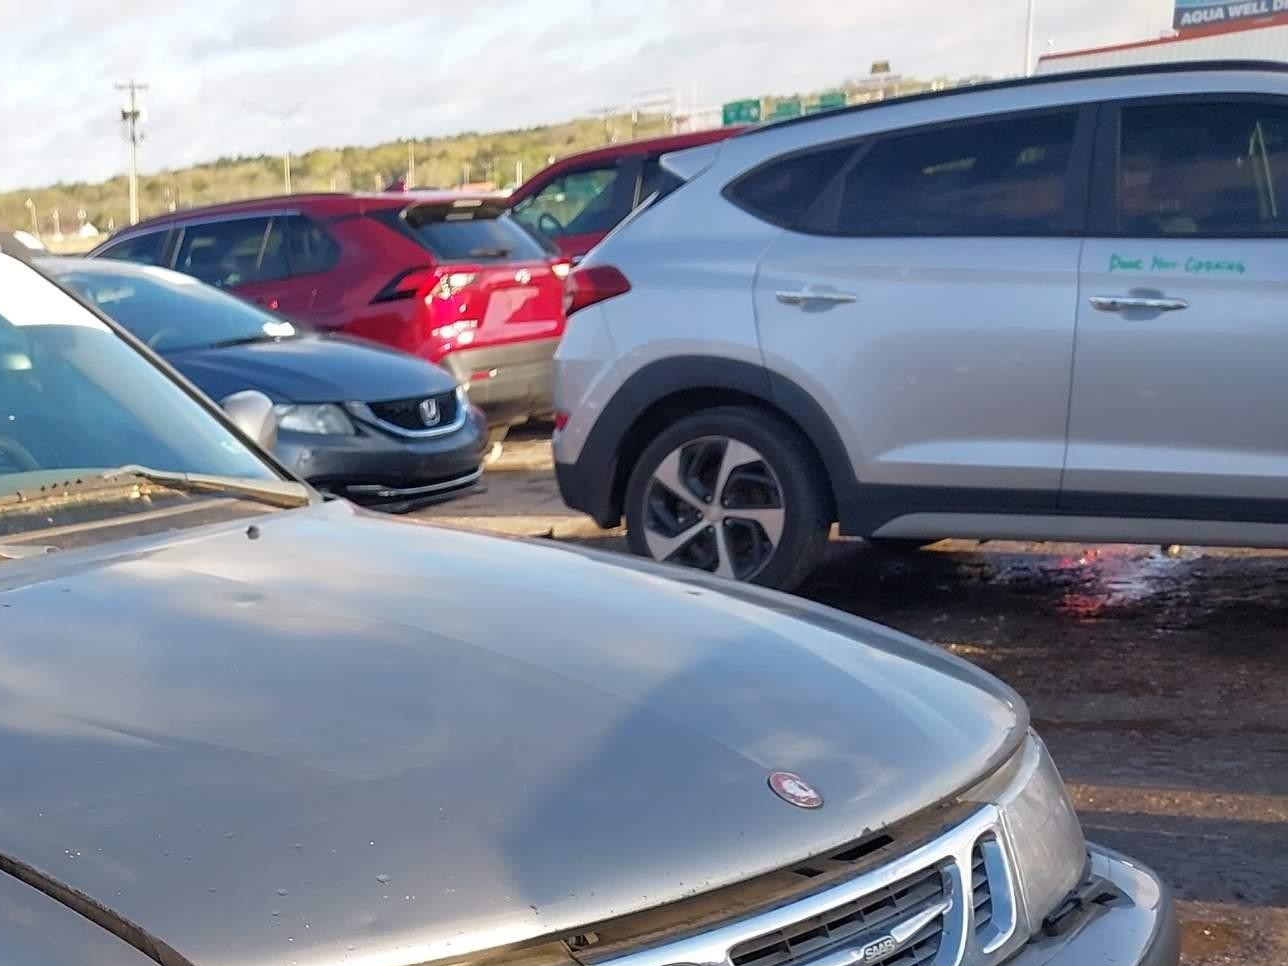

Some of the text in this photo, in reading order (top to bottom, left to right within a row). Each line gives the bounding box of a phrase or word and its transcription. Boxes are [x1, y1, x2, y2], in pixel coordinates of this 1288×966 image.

[1180, 7, 1225, 26] AQUA
[1228, 1, 1269, 18] WELL
[864, 939, 895, 961] SAAB
